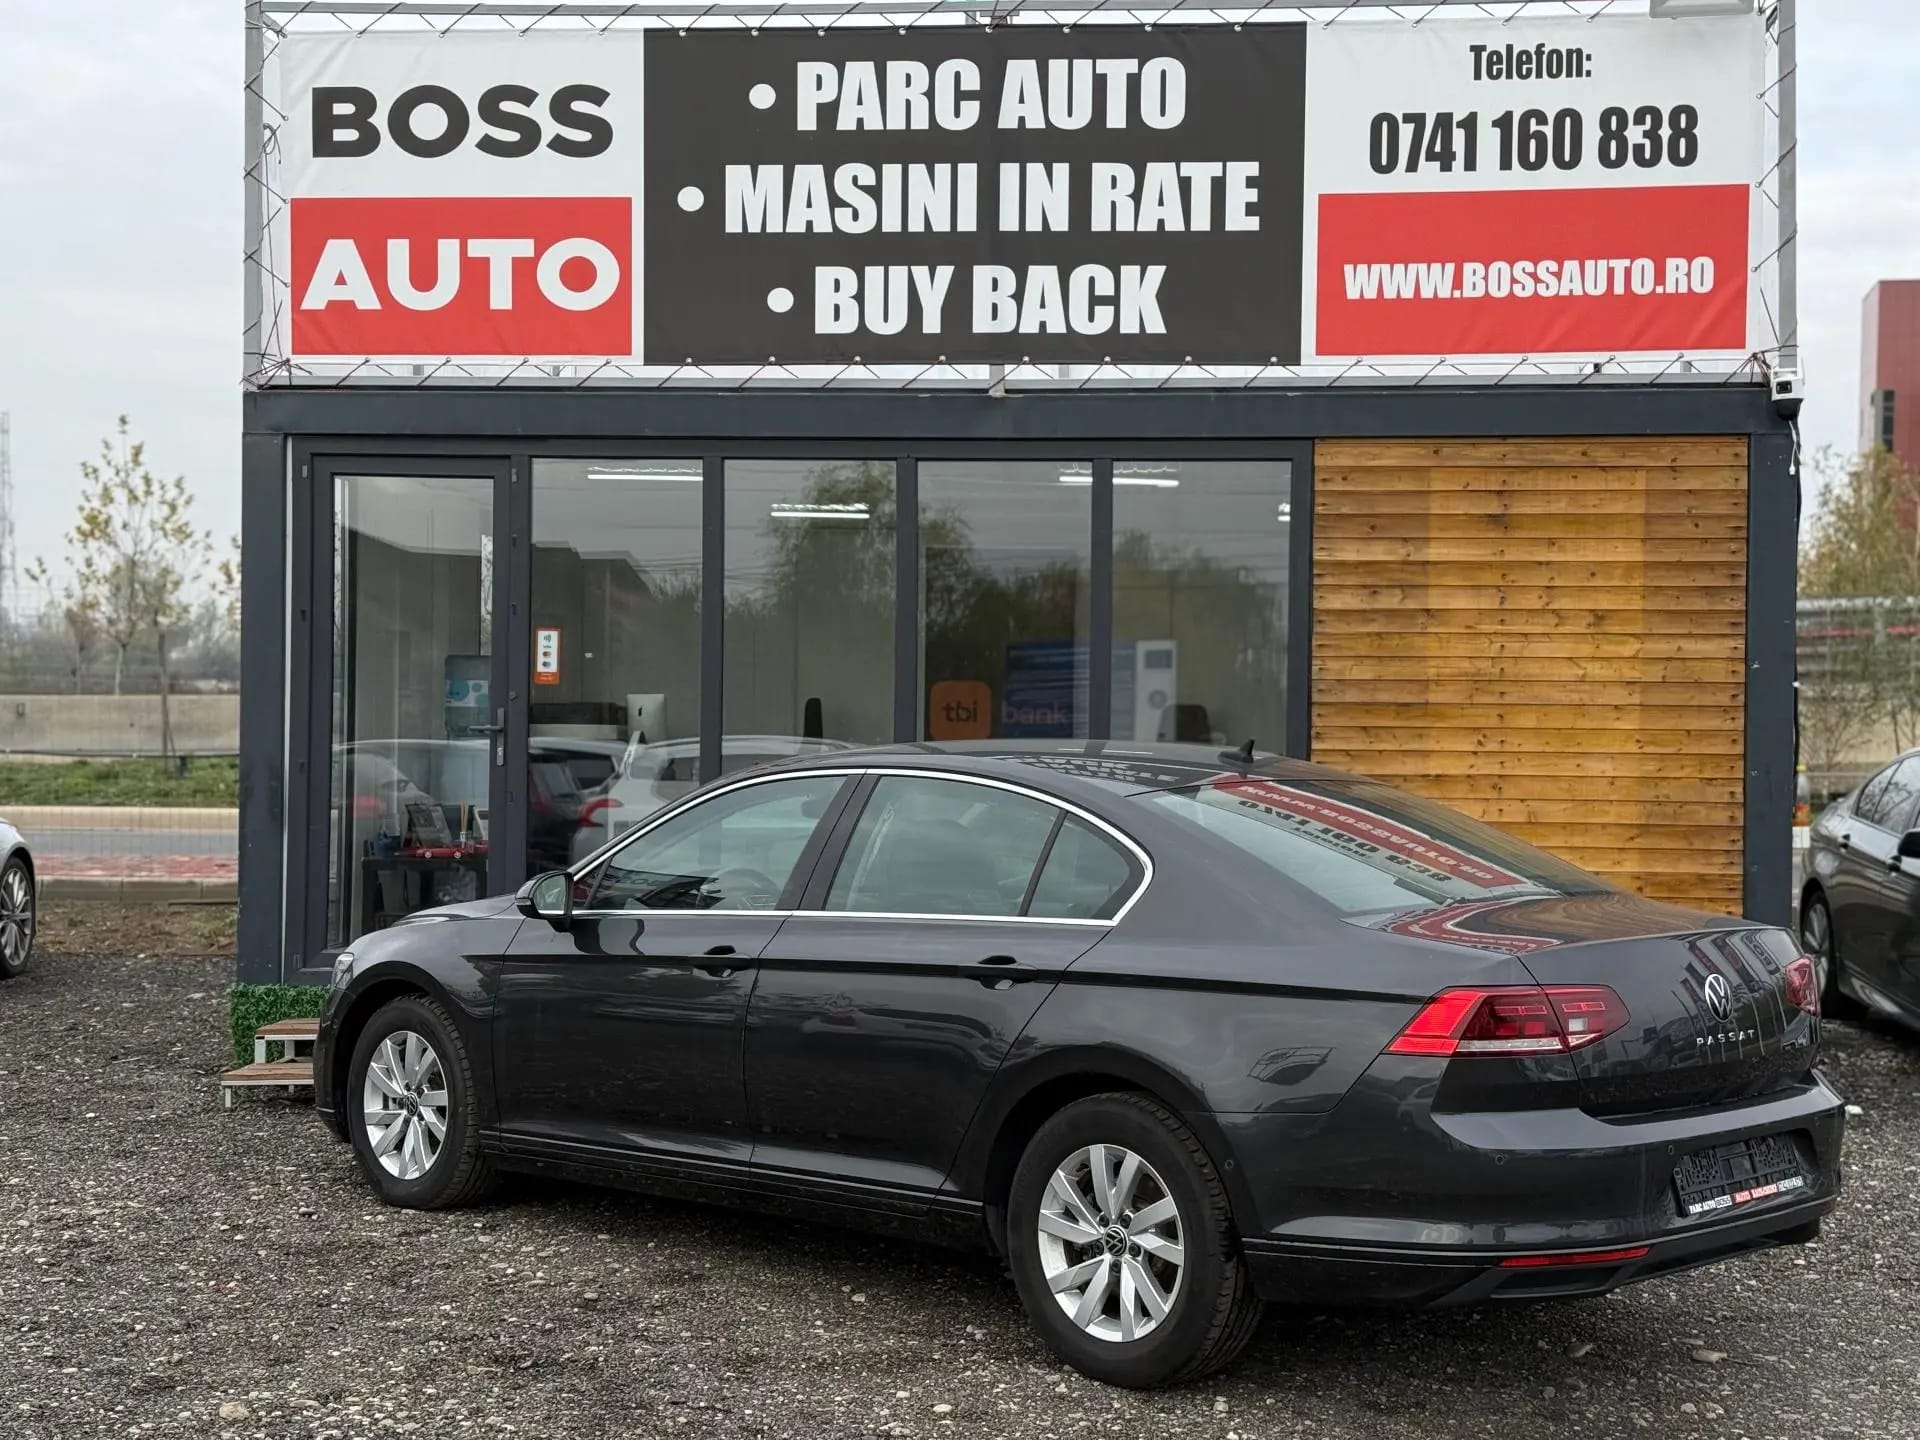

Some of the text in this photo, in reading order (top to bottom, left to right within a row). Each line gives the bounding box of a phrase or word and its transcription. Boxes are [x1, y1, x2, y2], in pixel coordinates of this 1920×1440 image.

[796, 56, 1187, 131] PARC AUTO
[1469, 43, 1593, 82] Telefon:
[311, 83, 614, 159] BOSS
[1368, 104, 1699, 175] 0741 160 838
[724, 161, 1261, 235] MASINI IN RATE
[300, 236, 621, 312] AUTO
[815, 263, 1167, 335] BUY BACK
[1342, 256, 1715, 301] WWW.BOSSAUTO.RO
[942, 700, 1067, 726] tbi bank
[1696, 1029, 1755, 1048] PASSAT
